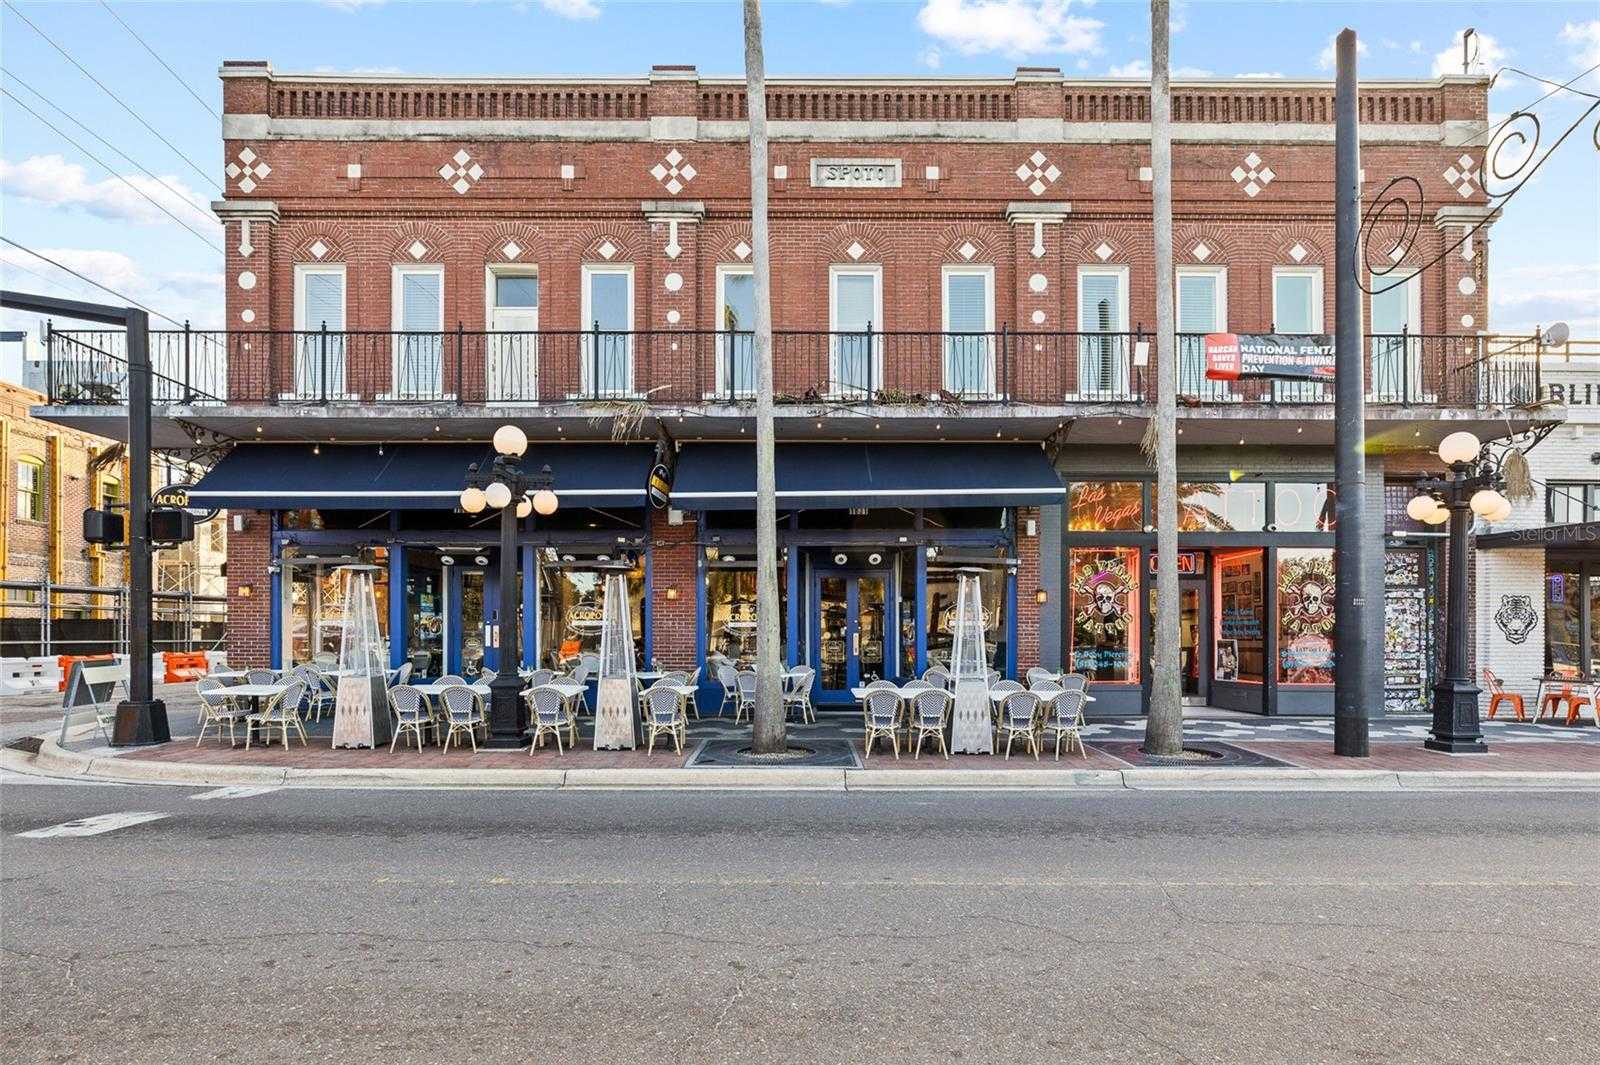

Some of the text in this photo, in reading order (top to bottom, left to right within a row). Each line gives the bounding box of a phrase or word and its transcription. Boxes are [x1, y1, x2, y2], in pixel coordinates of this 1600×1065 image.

[826, 166, 885, 181] SPOTO
[1241, 344, 1297, 355] NATIONAL
[1241, 354, 1295, 366] PREVENTION
[1242, 365, 1265, 373] DAY
[1072, 485, 1107, 509] Las
[1095, 502, 1141, 528] Vegas
[1149, 555, 1194, 573] OEN
[1075, 611, 1135, 635] TATTOO
